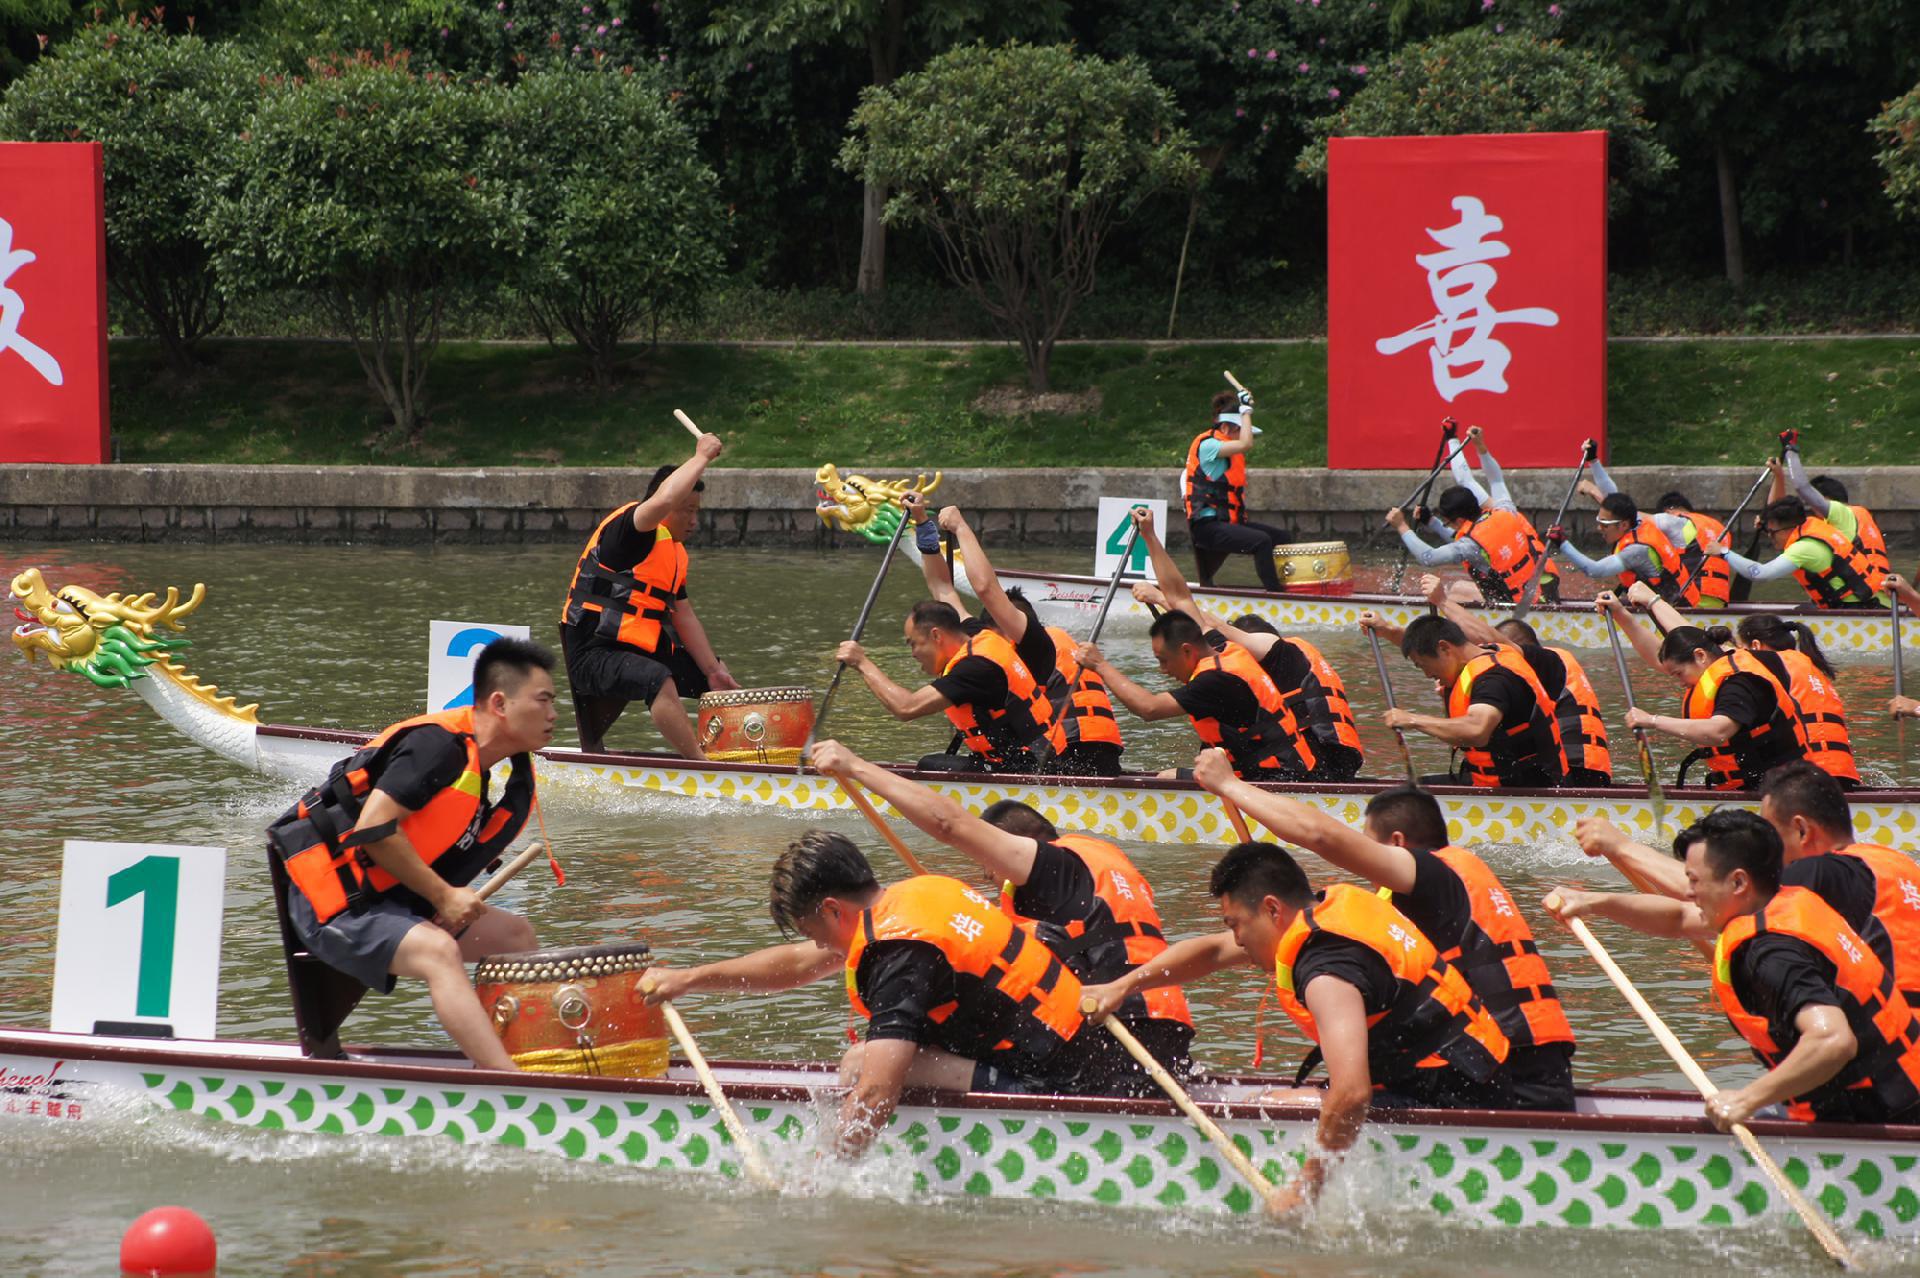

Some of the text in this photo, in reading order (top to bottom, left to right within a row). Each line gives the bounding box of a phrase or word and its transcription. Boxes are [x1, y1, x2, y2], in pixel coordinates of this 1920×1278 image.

[1375, 195, 1560, 403] 喜
[1106, 504, 1150, 571] 4
[106, 855, 180, 1018] 1
